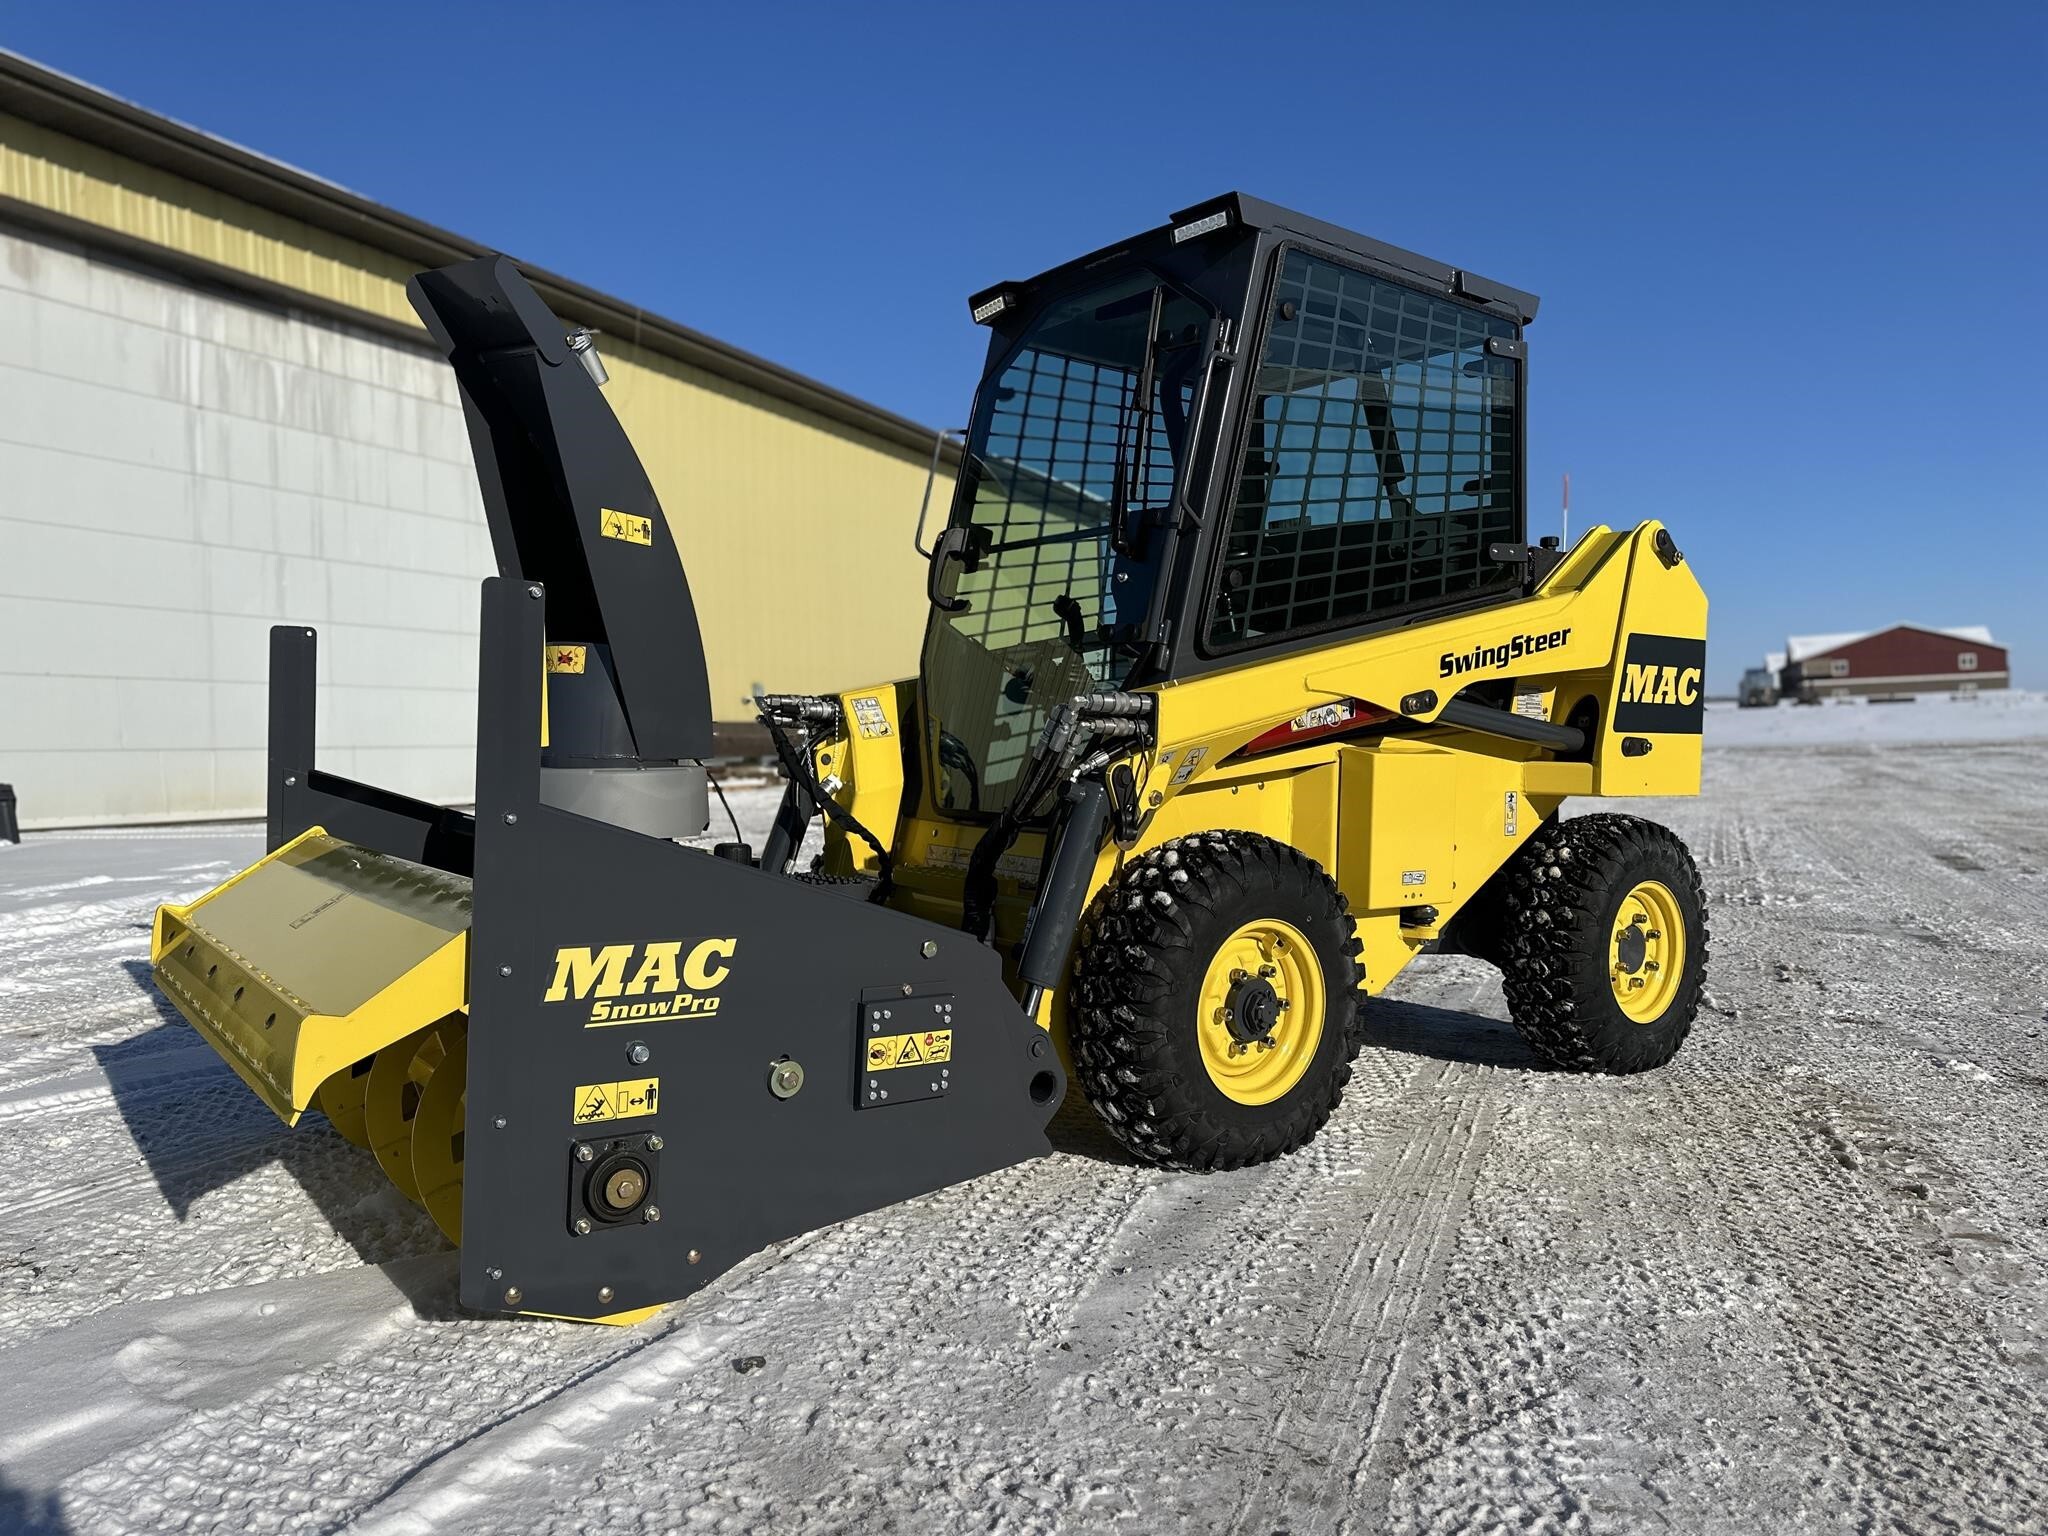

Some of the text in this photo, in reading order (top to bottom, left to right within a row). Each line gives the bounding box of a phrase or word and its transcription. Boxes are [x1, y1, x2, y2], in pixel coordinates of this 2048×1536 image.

[1439, 628, 1571, 679] SwingSteer
[1621, 663, 1701, 706] MAC
[544, 938, 737, 1003] MAC
[590, 994, 721, 1021] SnowPro
